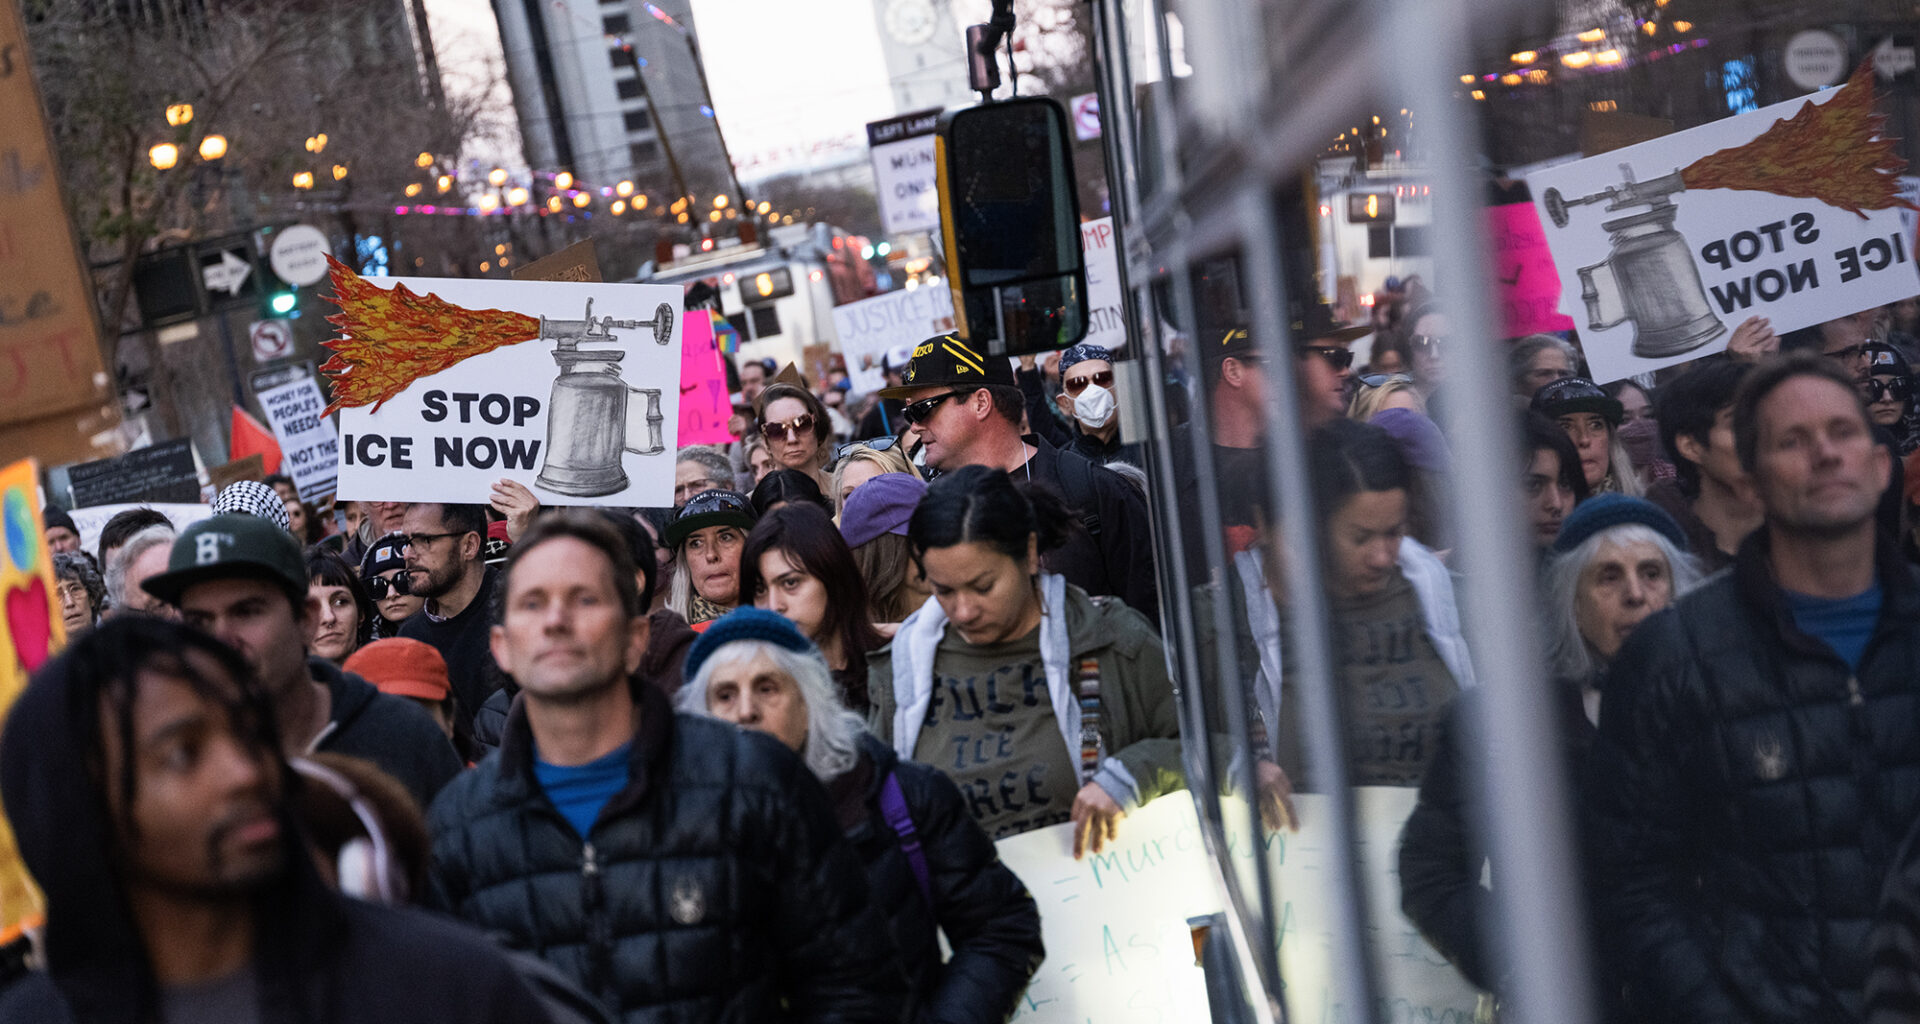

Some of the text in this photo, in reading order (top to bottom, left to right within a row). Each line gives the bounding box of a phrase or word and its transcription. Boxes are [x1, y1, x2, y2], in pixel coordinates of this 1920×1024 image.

[874, 123, 905, 138] LEFT
[844, 291, 928, 339] JUSTICE
[266, 384, 313, 406] MONEY FOR
[273, 397, 319, 420] PEOPLE'S
[421, 390, 541, 427] STOP
[283, 414, 321, 437] NEEDS
[290, 439, 338, 466] NOT THE
[344, 434, 541, 470] ICE NOW
[962, 764, 1050, 819] REE
